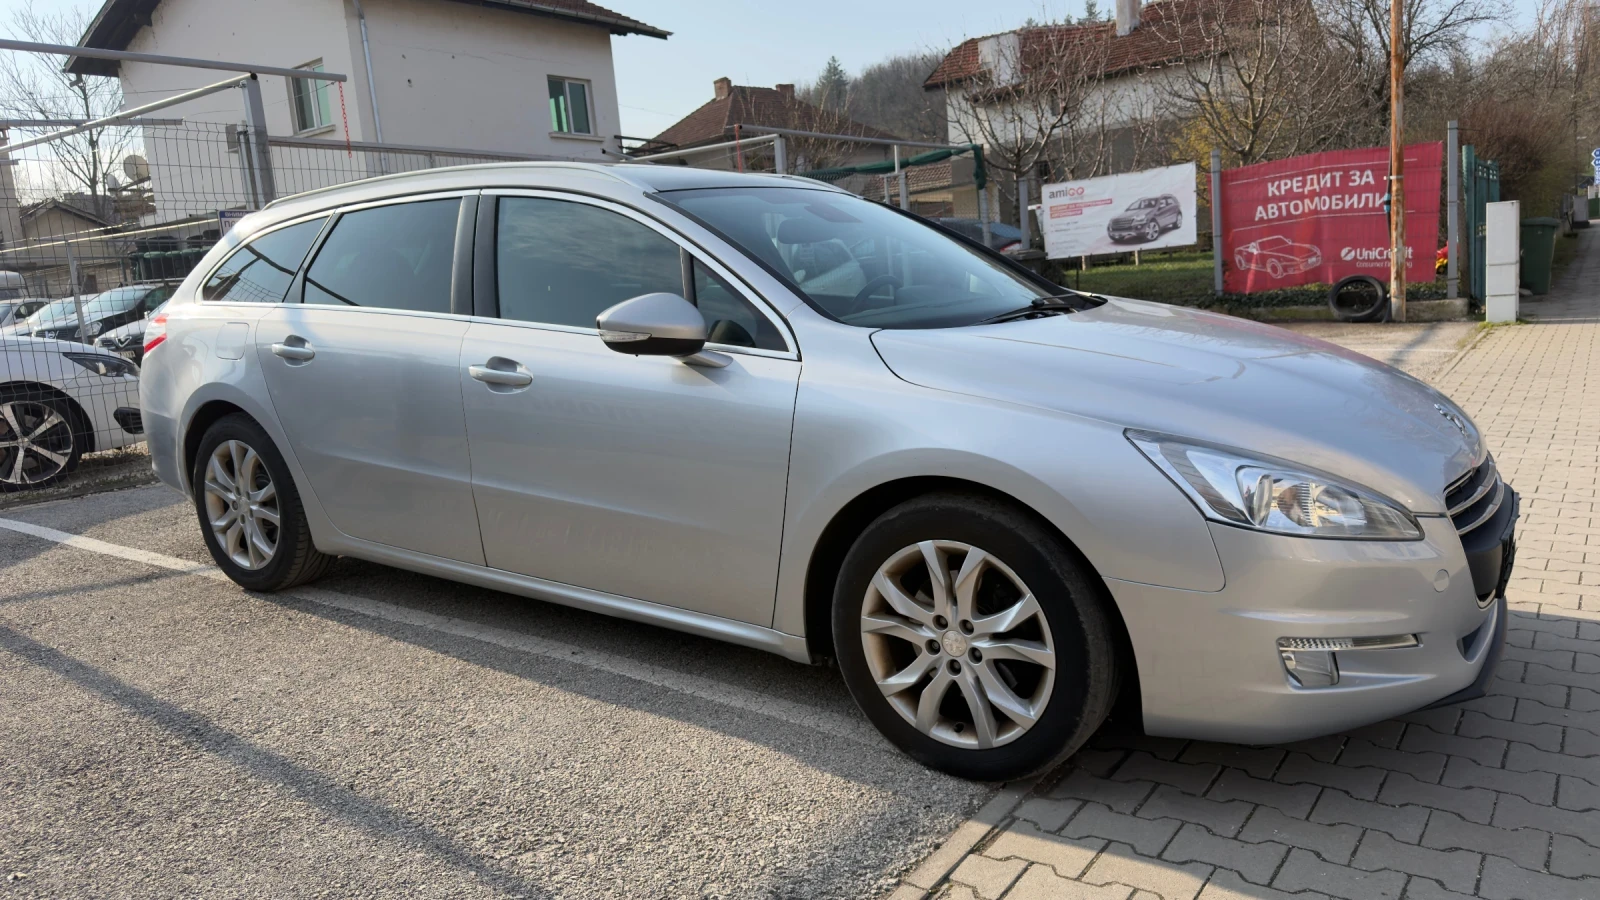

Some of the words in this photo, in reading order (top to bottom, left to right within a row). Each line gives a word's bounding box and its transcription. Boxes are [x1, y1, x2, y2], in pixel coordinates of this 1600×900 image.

[1267, 171, 1343, 197] КРЕДИТ
[1348, 169, 1375, 187] ЗА
[1254, 192, 1386, 221] АВТОМОБИЛИ
[1356, 246, 1413, 260] UniCrit
